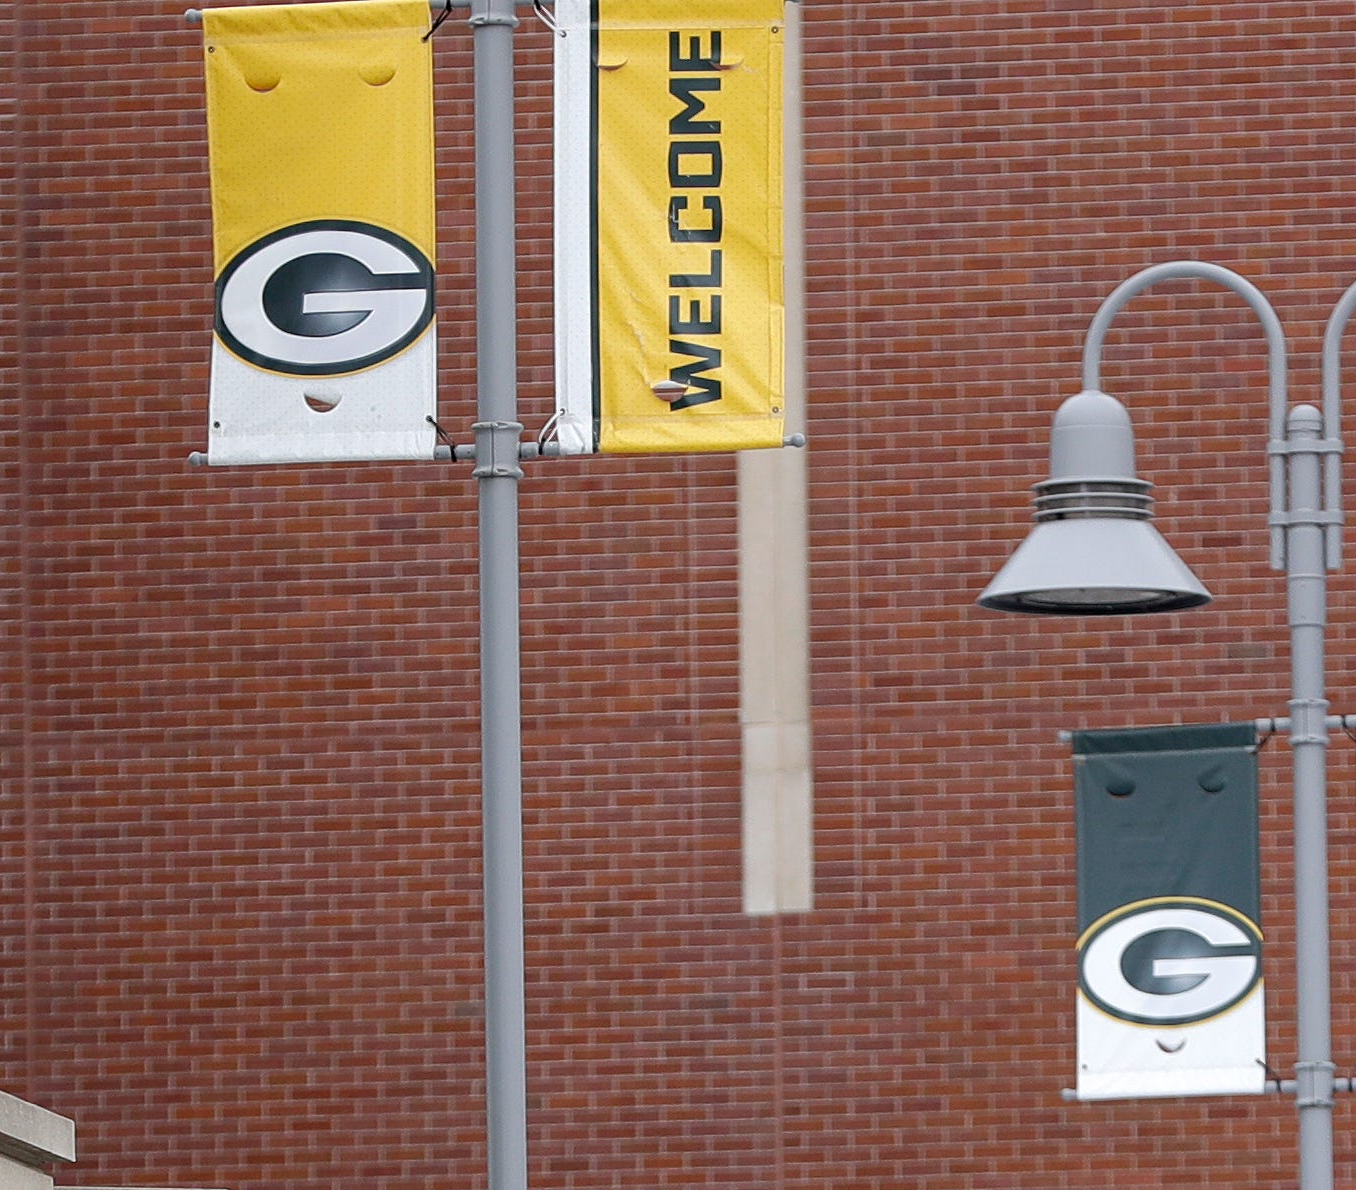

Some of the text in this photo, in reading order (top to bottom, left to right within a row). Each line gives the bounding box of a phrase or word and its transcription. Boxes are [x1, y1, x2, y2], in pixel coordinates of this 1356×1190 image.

[668, 29, 722, 412] WELCOME
[221, 229, 428, 364] G
[1082, 908, 1257, 1020] G
